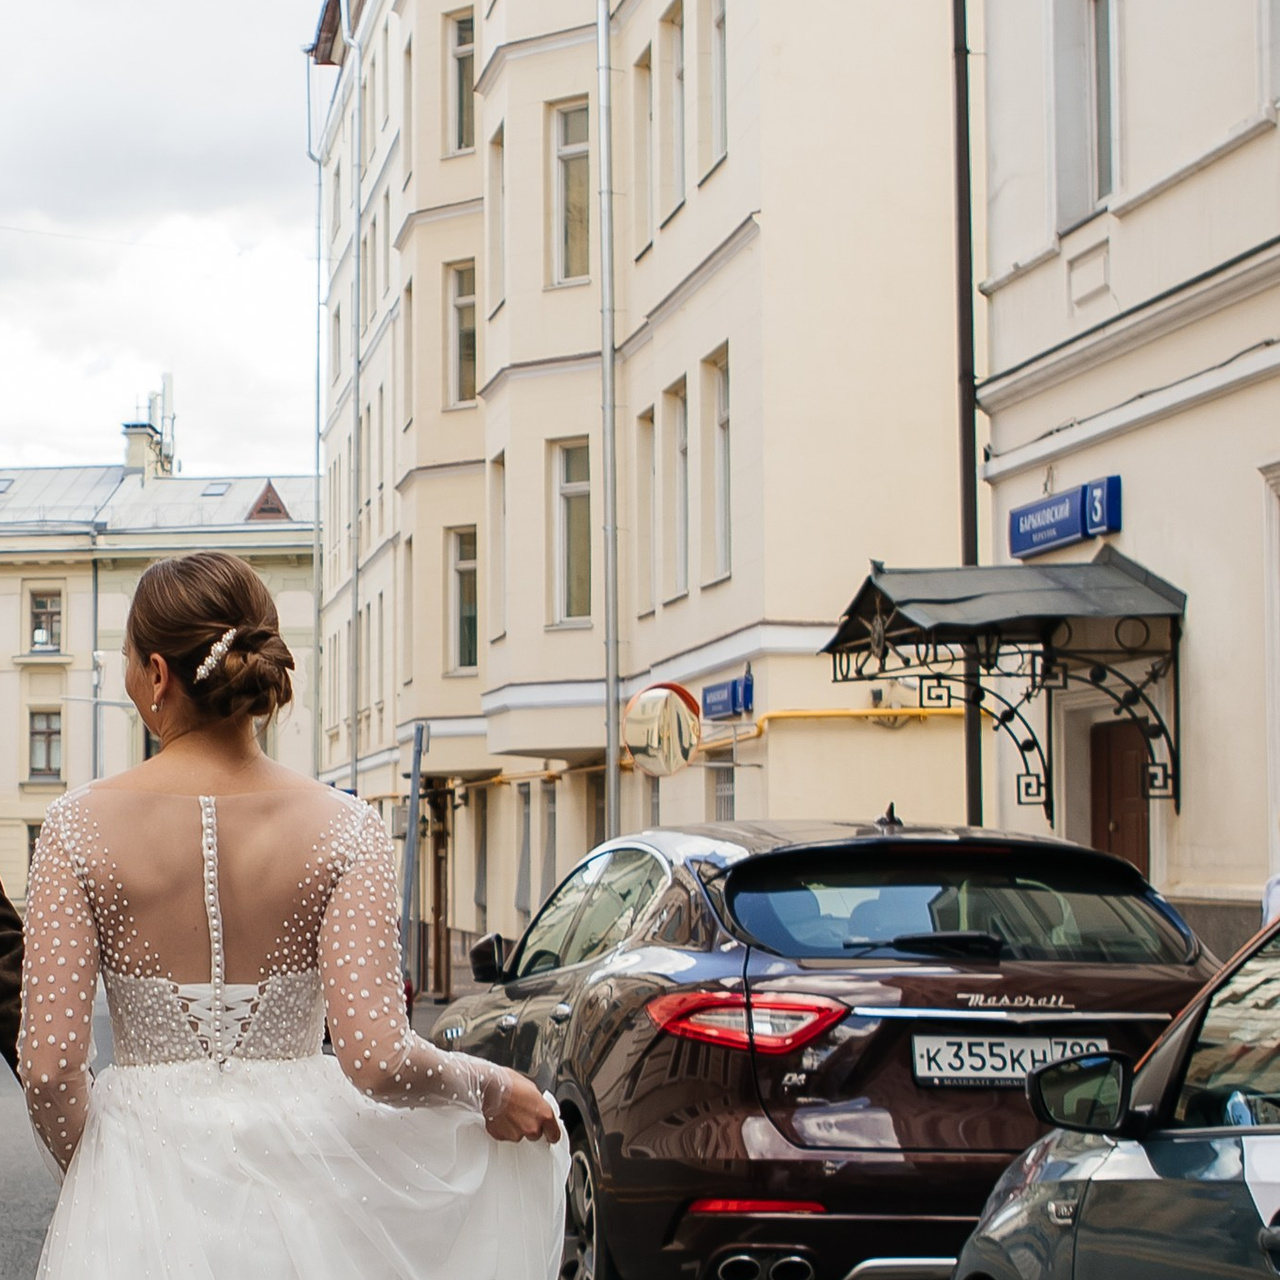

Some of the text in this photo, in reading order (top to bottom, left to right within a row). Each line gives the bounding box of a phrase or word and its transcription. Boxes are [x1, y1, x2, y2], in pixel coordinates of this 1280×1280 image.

[1019, 498, 1070, 533] БАРЫКОВСКИЙ
[1091, 487, 1103, 522] 3
[956, 992, 1076, 1009] Maserati
